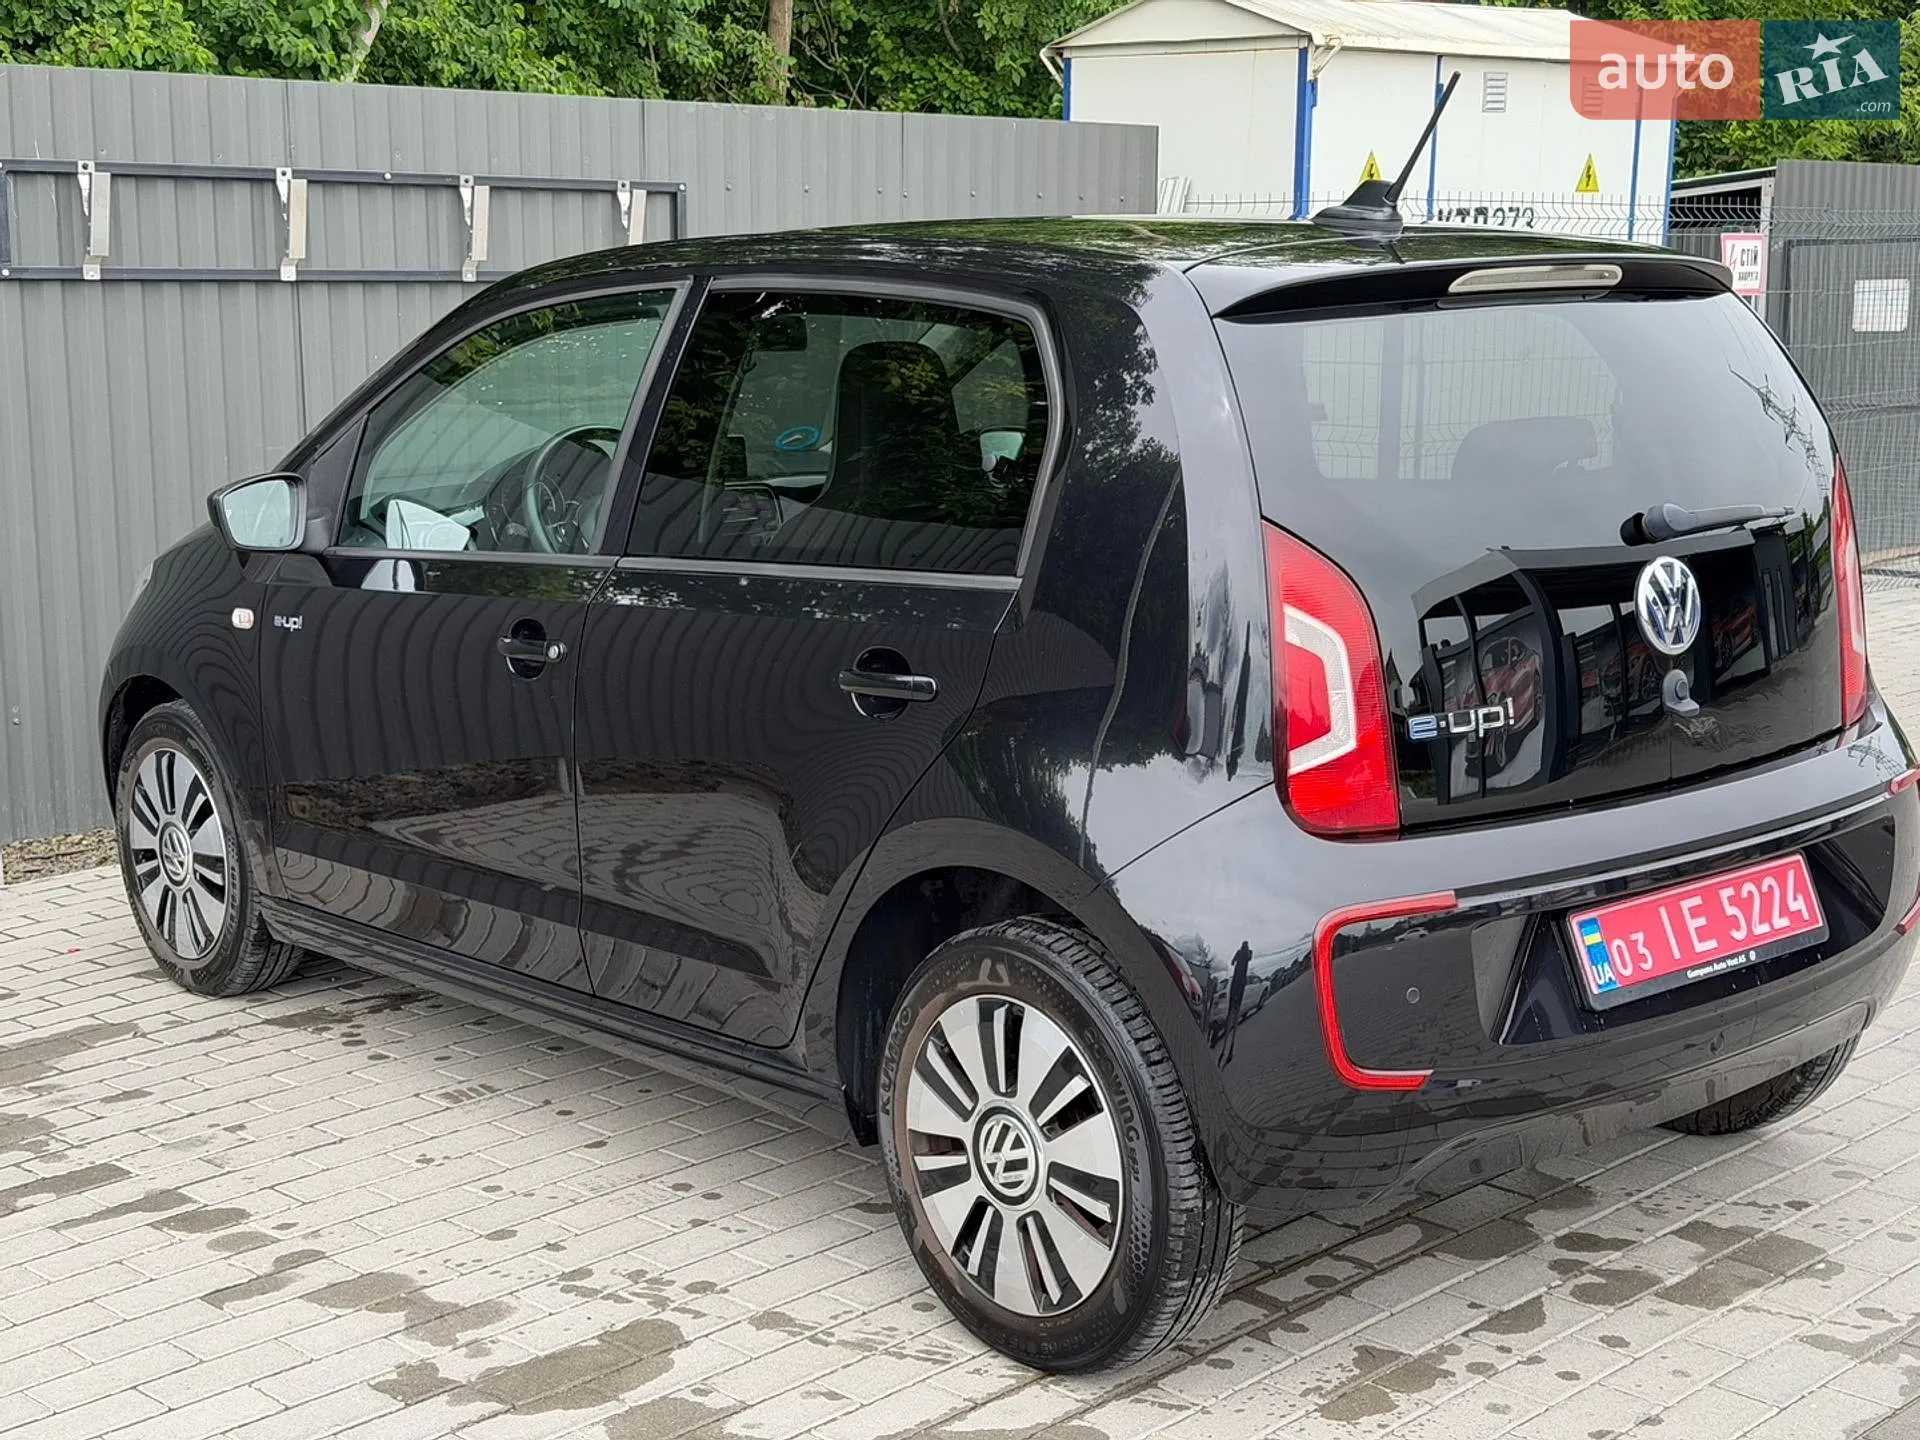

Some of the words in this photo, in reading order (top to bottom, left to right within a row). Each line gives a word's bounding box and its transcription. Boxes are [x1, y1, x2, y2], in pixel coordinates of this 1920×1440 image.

[1611, 931, 1654, 977] 03
[1658, 895, 1719, 960] IE
[1718, 868, 1810, 942] 5224
[1591, 963, 1616, 985] UA
